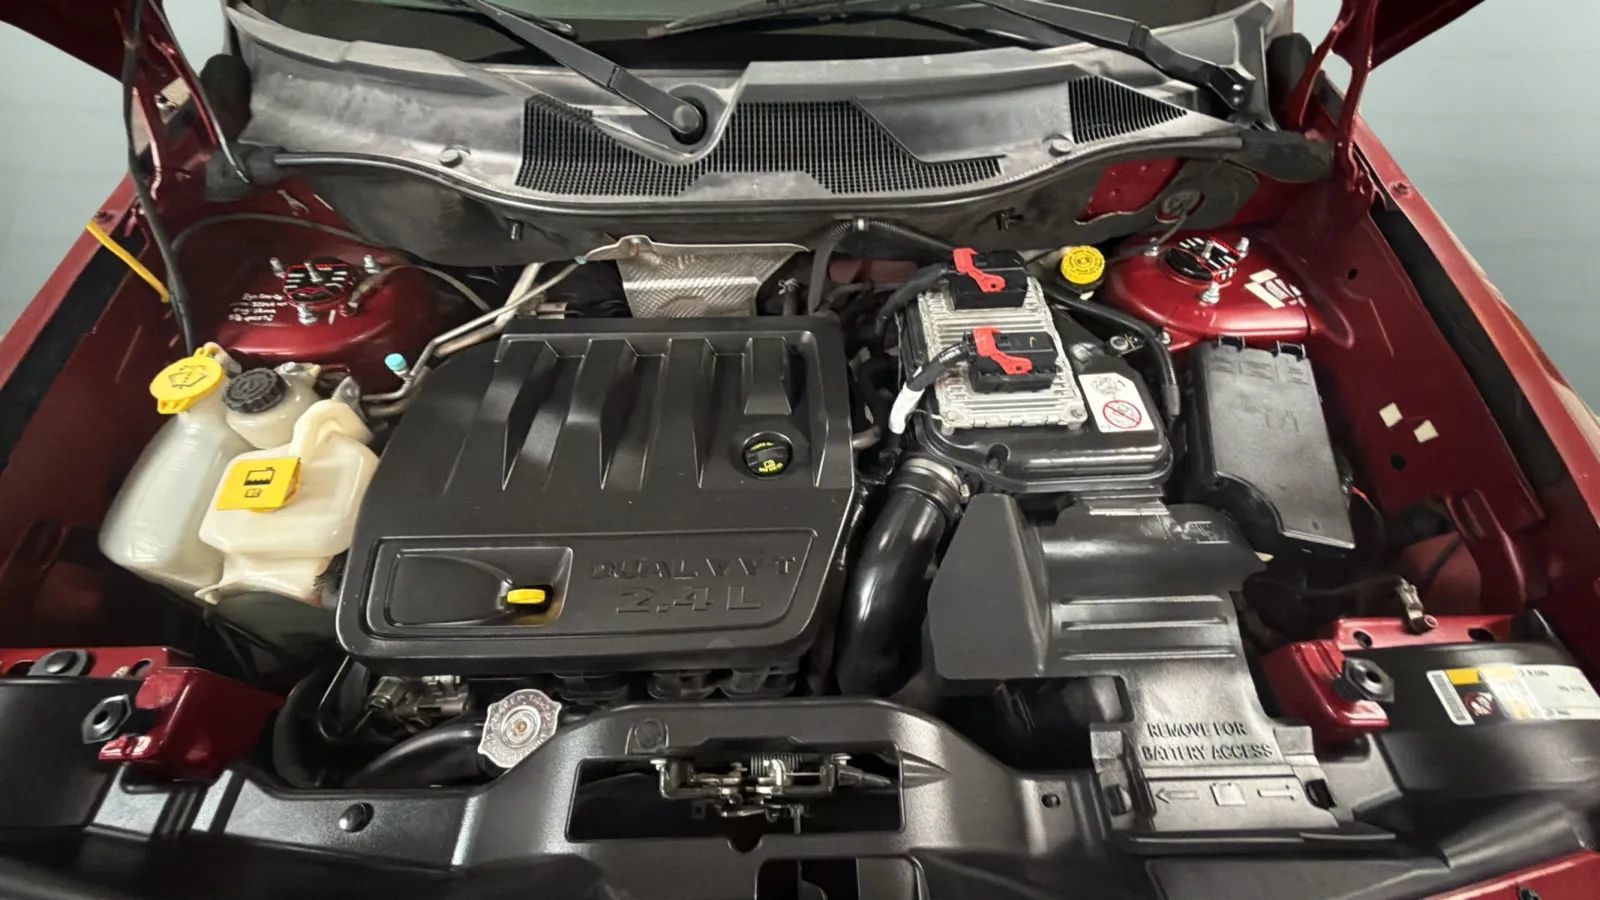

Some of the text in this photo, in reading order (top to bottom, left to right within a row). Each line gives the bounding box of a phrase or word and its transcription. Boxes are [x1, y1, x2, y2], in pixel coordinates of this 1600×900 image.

[588, 556, 700, 580] DUAL
[615, 584, 763, 614] 2.4L
[1146, 720, 1248, 738] REMOVE FOR
[1141, 743, 1273, 761] BATTERY ACCESS
